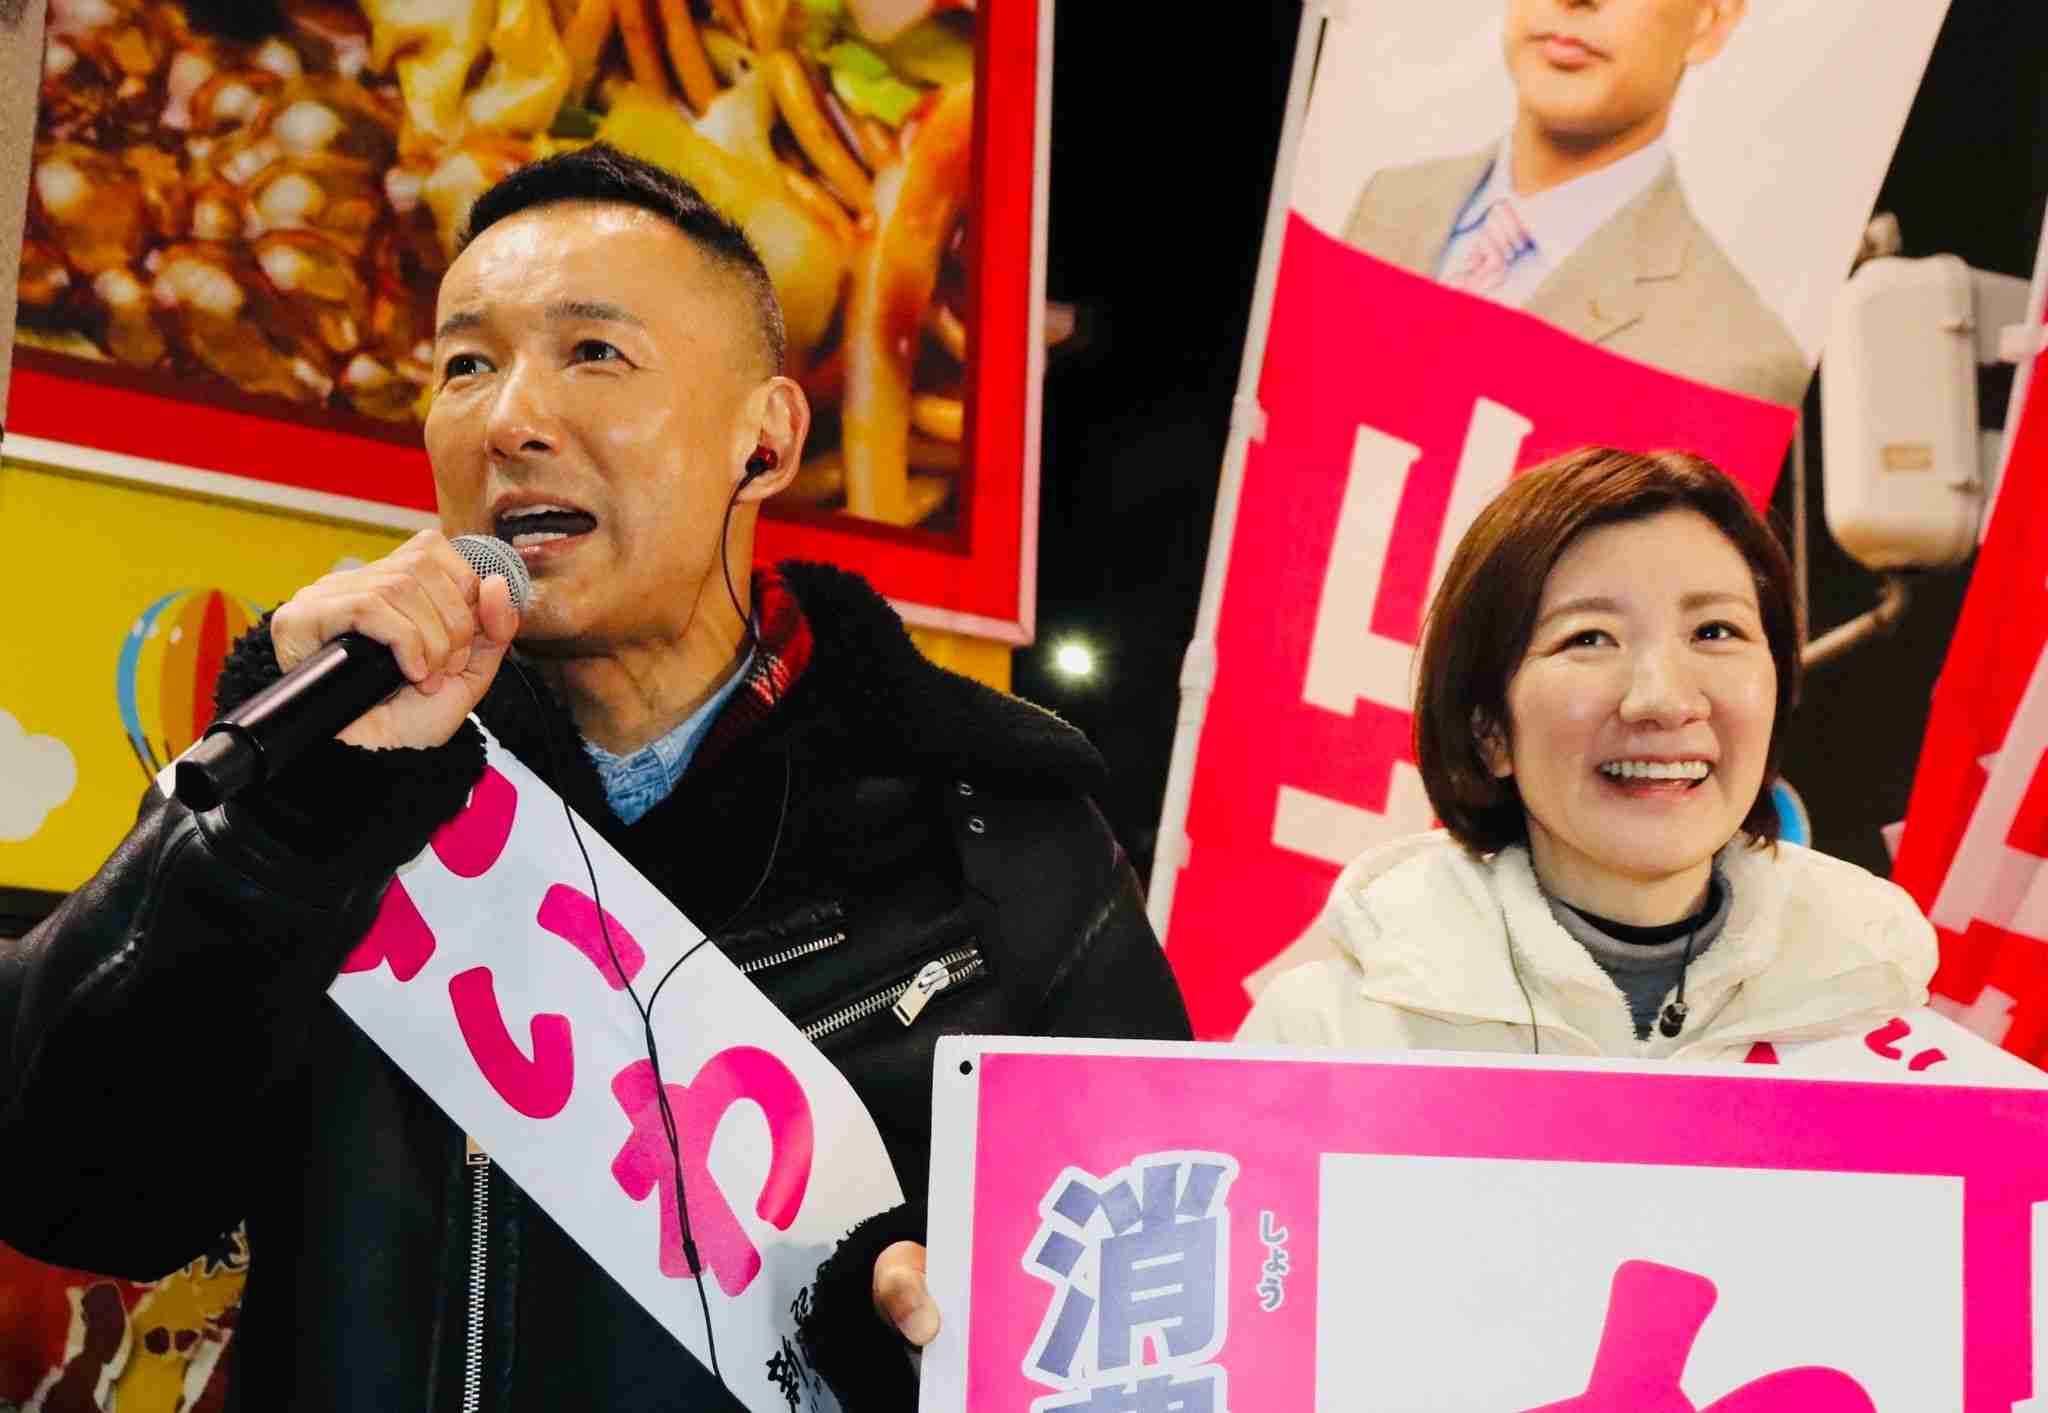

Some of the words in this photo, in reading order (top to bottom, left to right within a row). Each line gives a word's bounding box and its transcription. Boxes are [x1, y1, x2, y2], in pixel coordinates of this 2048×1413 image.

[1028, 1158, 1234, 1413] 消
[1257, 1211, 1288, 1311] しょう
